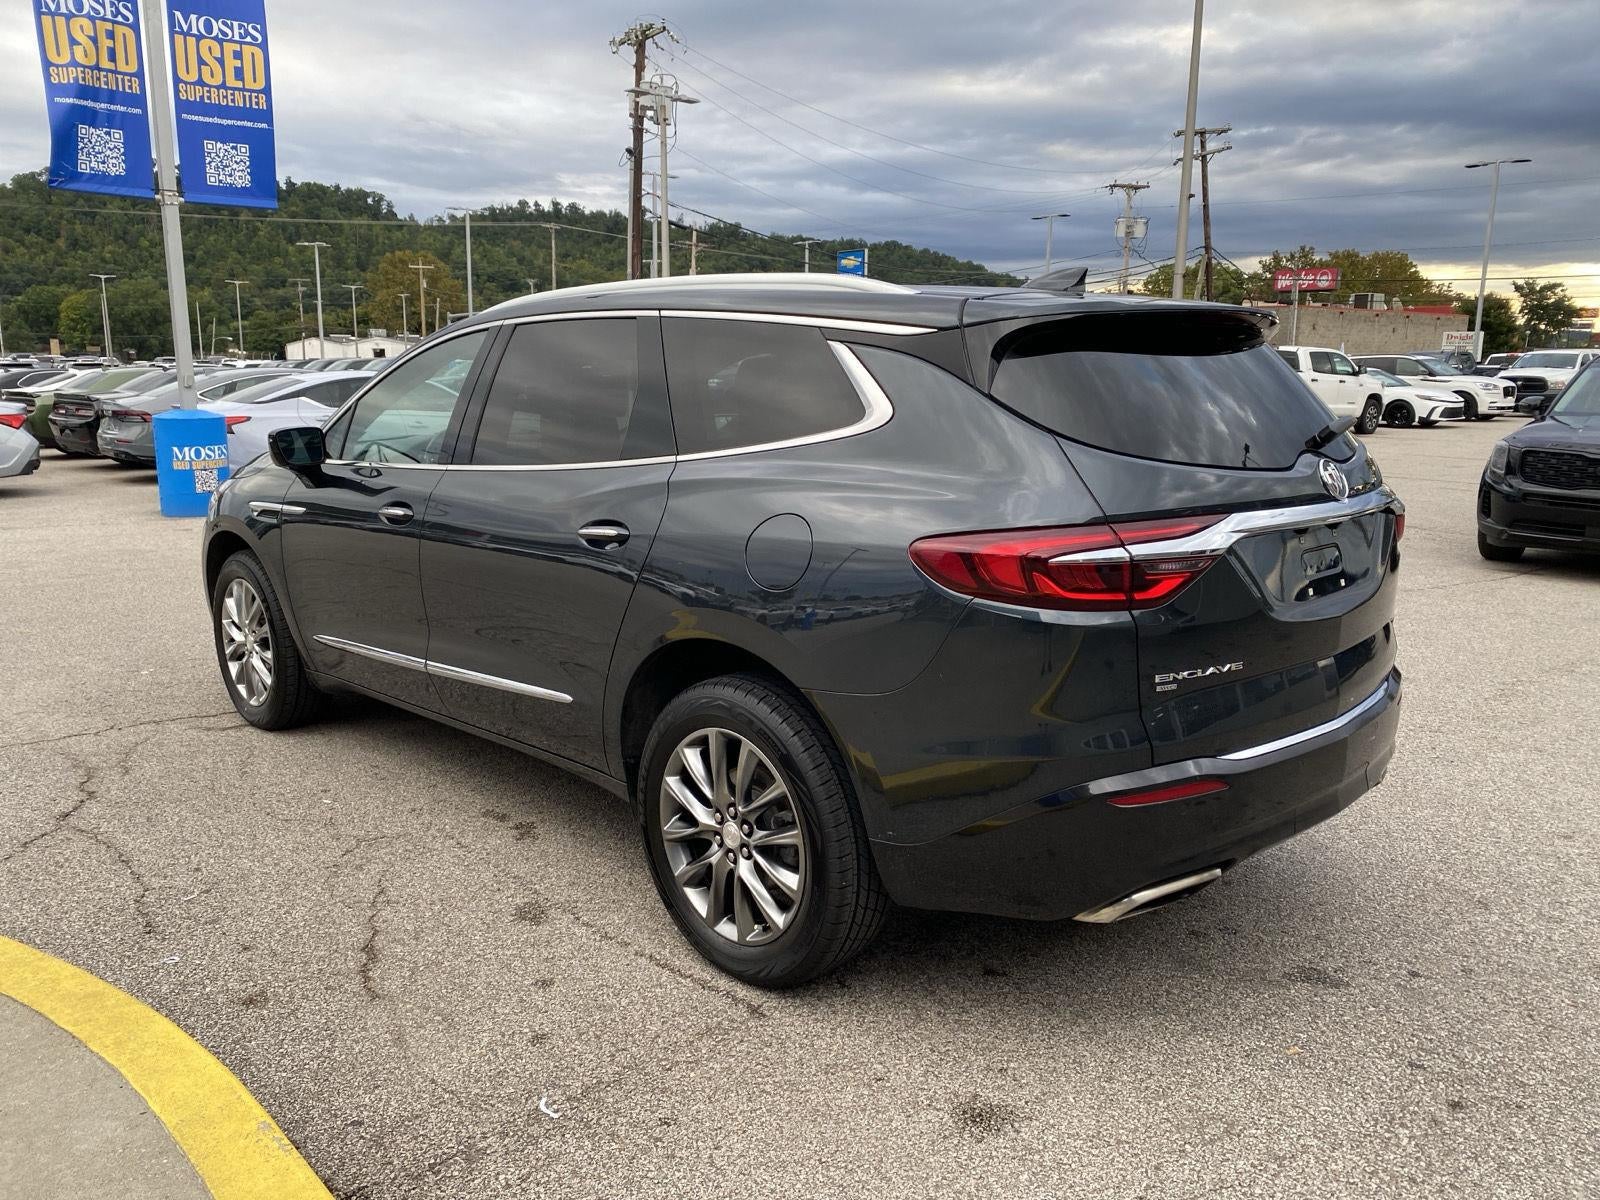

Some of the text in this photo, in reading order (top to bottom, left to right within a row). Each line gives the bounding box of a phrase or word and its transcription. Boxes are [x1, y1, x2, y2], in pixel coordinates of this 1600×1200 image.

[40, 0, 134, 24] MOSES
[173, 10, 262, 44] MOSES
[41, 15, 138, 73] USED
[174, 33, 266, 90] USED
[49, 66, 141, 94] SUPERCENTER
[54, 97, 142, 115] mosesusedsupercenter.com
[178, 83, 267, 110] SUPERCENTER
[181, 113, 268, 129] mosesusedsupercenter.com
[172, 444, 227, 461] MOSES
[173, 461, 190, 470] USED
[1155, 661, 1244, 683] ENCLAVE
